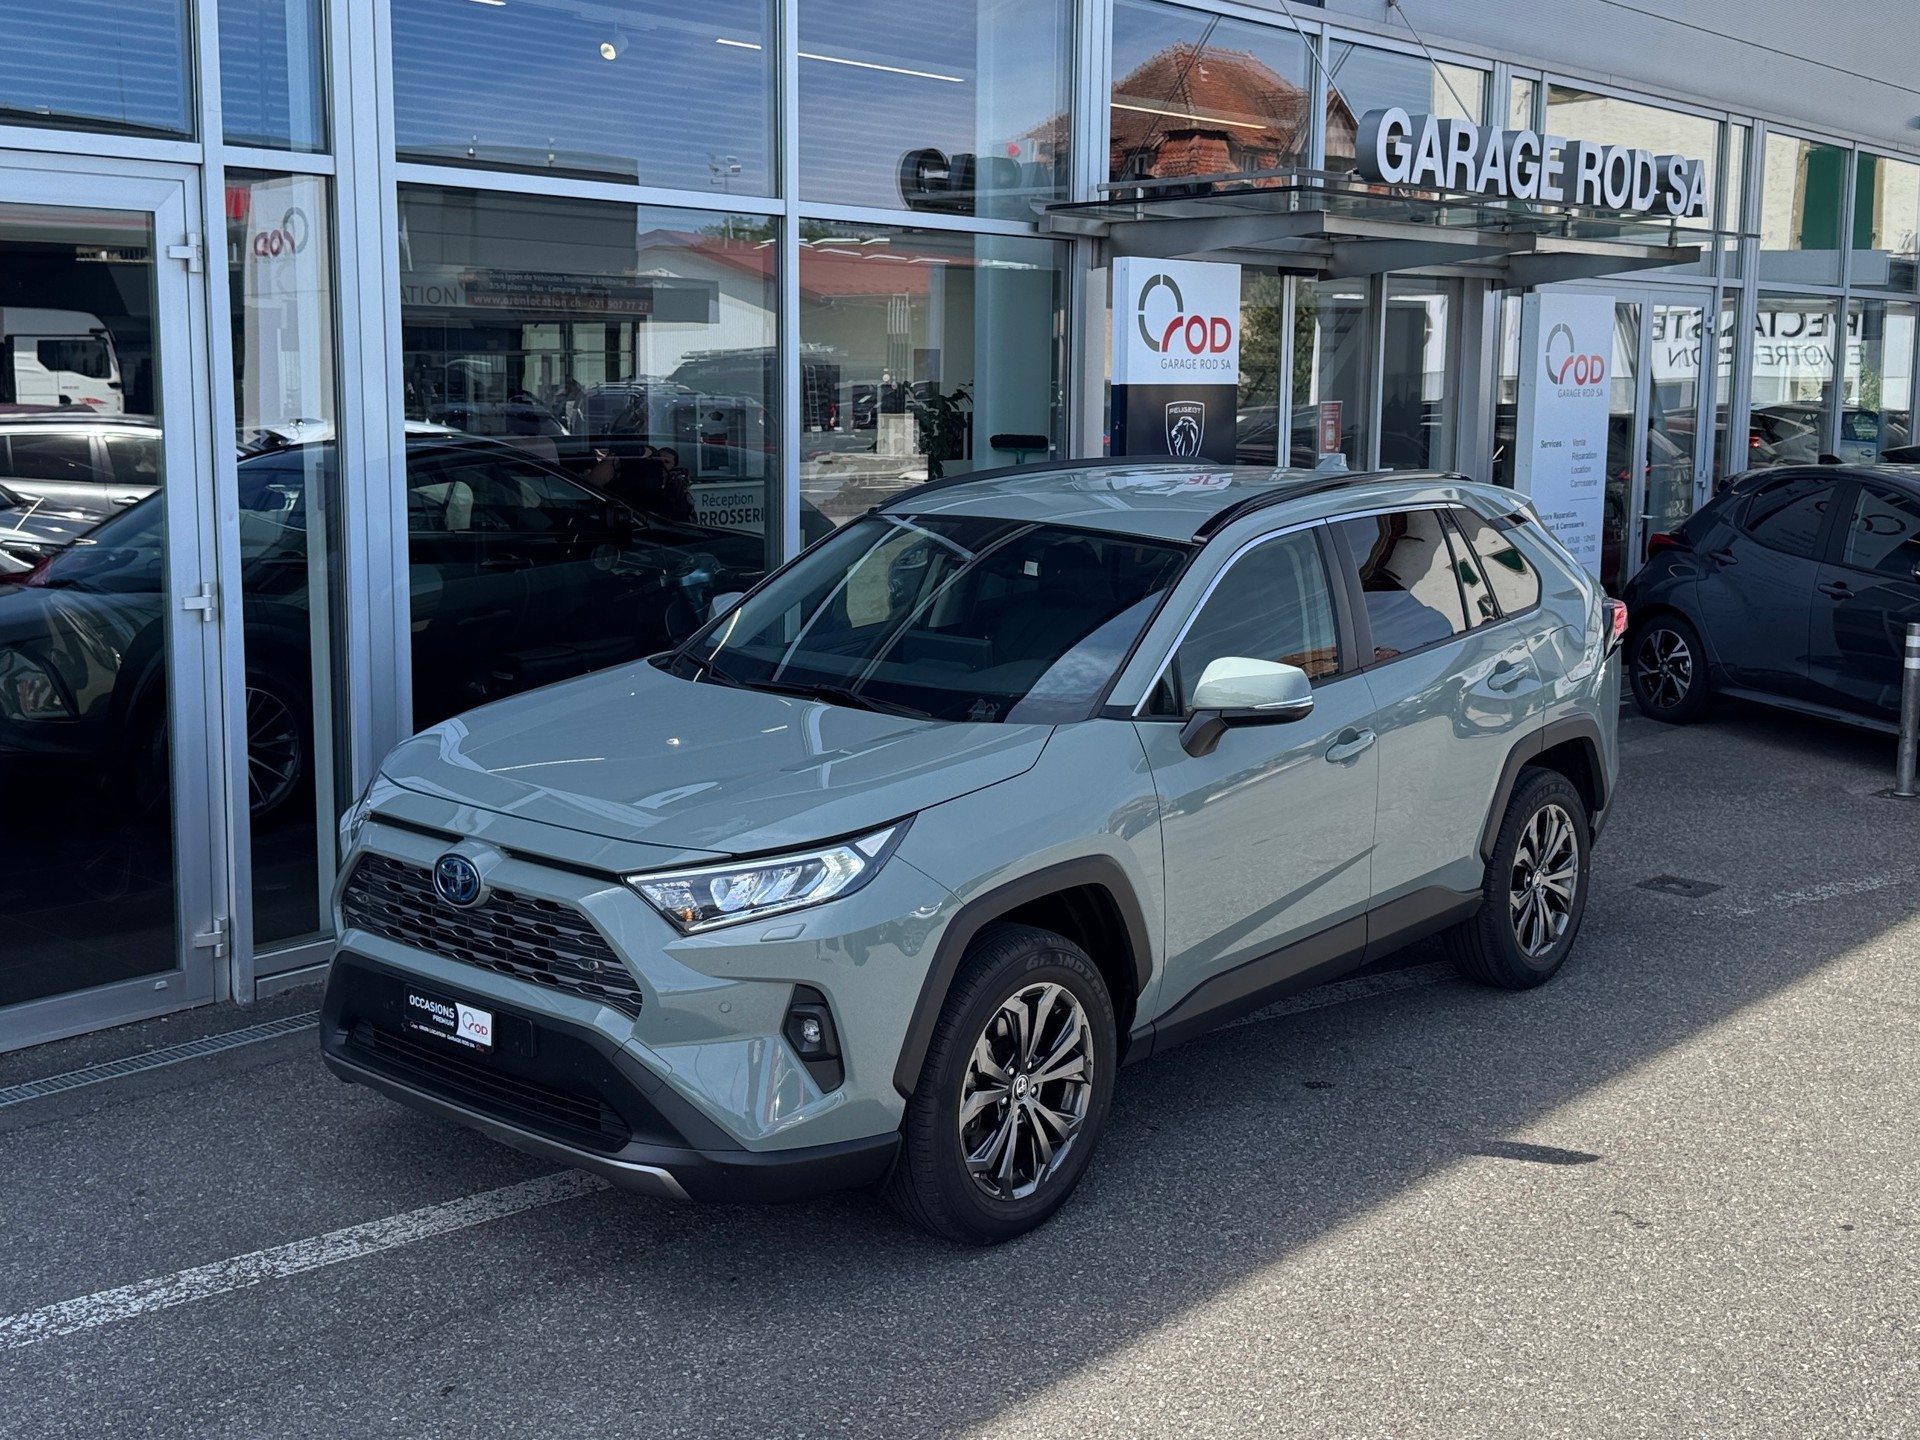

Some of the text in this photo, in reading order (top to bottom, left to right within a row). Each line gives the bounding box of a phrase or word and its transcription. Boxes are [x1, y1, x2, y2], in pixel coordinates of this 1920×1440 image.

[1377, 106, 1709, 218] GARAGE ROD SA
[505, 272, 523, 282] types
[524, 273, 532, 281] de
[507, 283, 528, 292] places
[589, 300, 605, 309] 021
[608, 301, 624, 310] 907
[625, 301, 637, 311] 77
[638, 302, 648, 312] 27
[1161, 358, 1231, 370] GARAGE ROD SA
[1557, 388, 1603, 398] GARAGE ROD SA
[1169, 406, 1202, 414] PEUGEOT
[1540, 440, 1562, 449] Services
[1573, 438, 1586, 447] Vente
[1571, 465, 1592, 475] Location
[1570, 479, 1598, 488] Carrosserie
[702, 492, 754, 508] Réception
[409, 994, 455, 1019] OCCASIONS
[432, 1014, 455, 1028] PREMIUM
